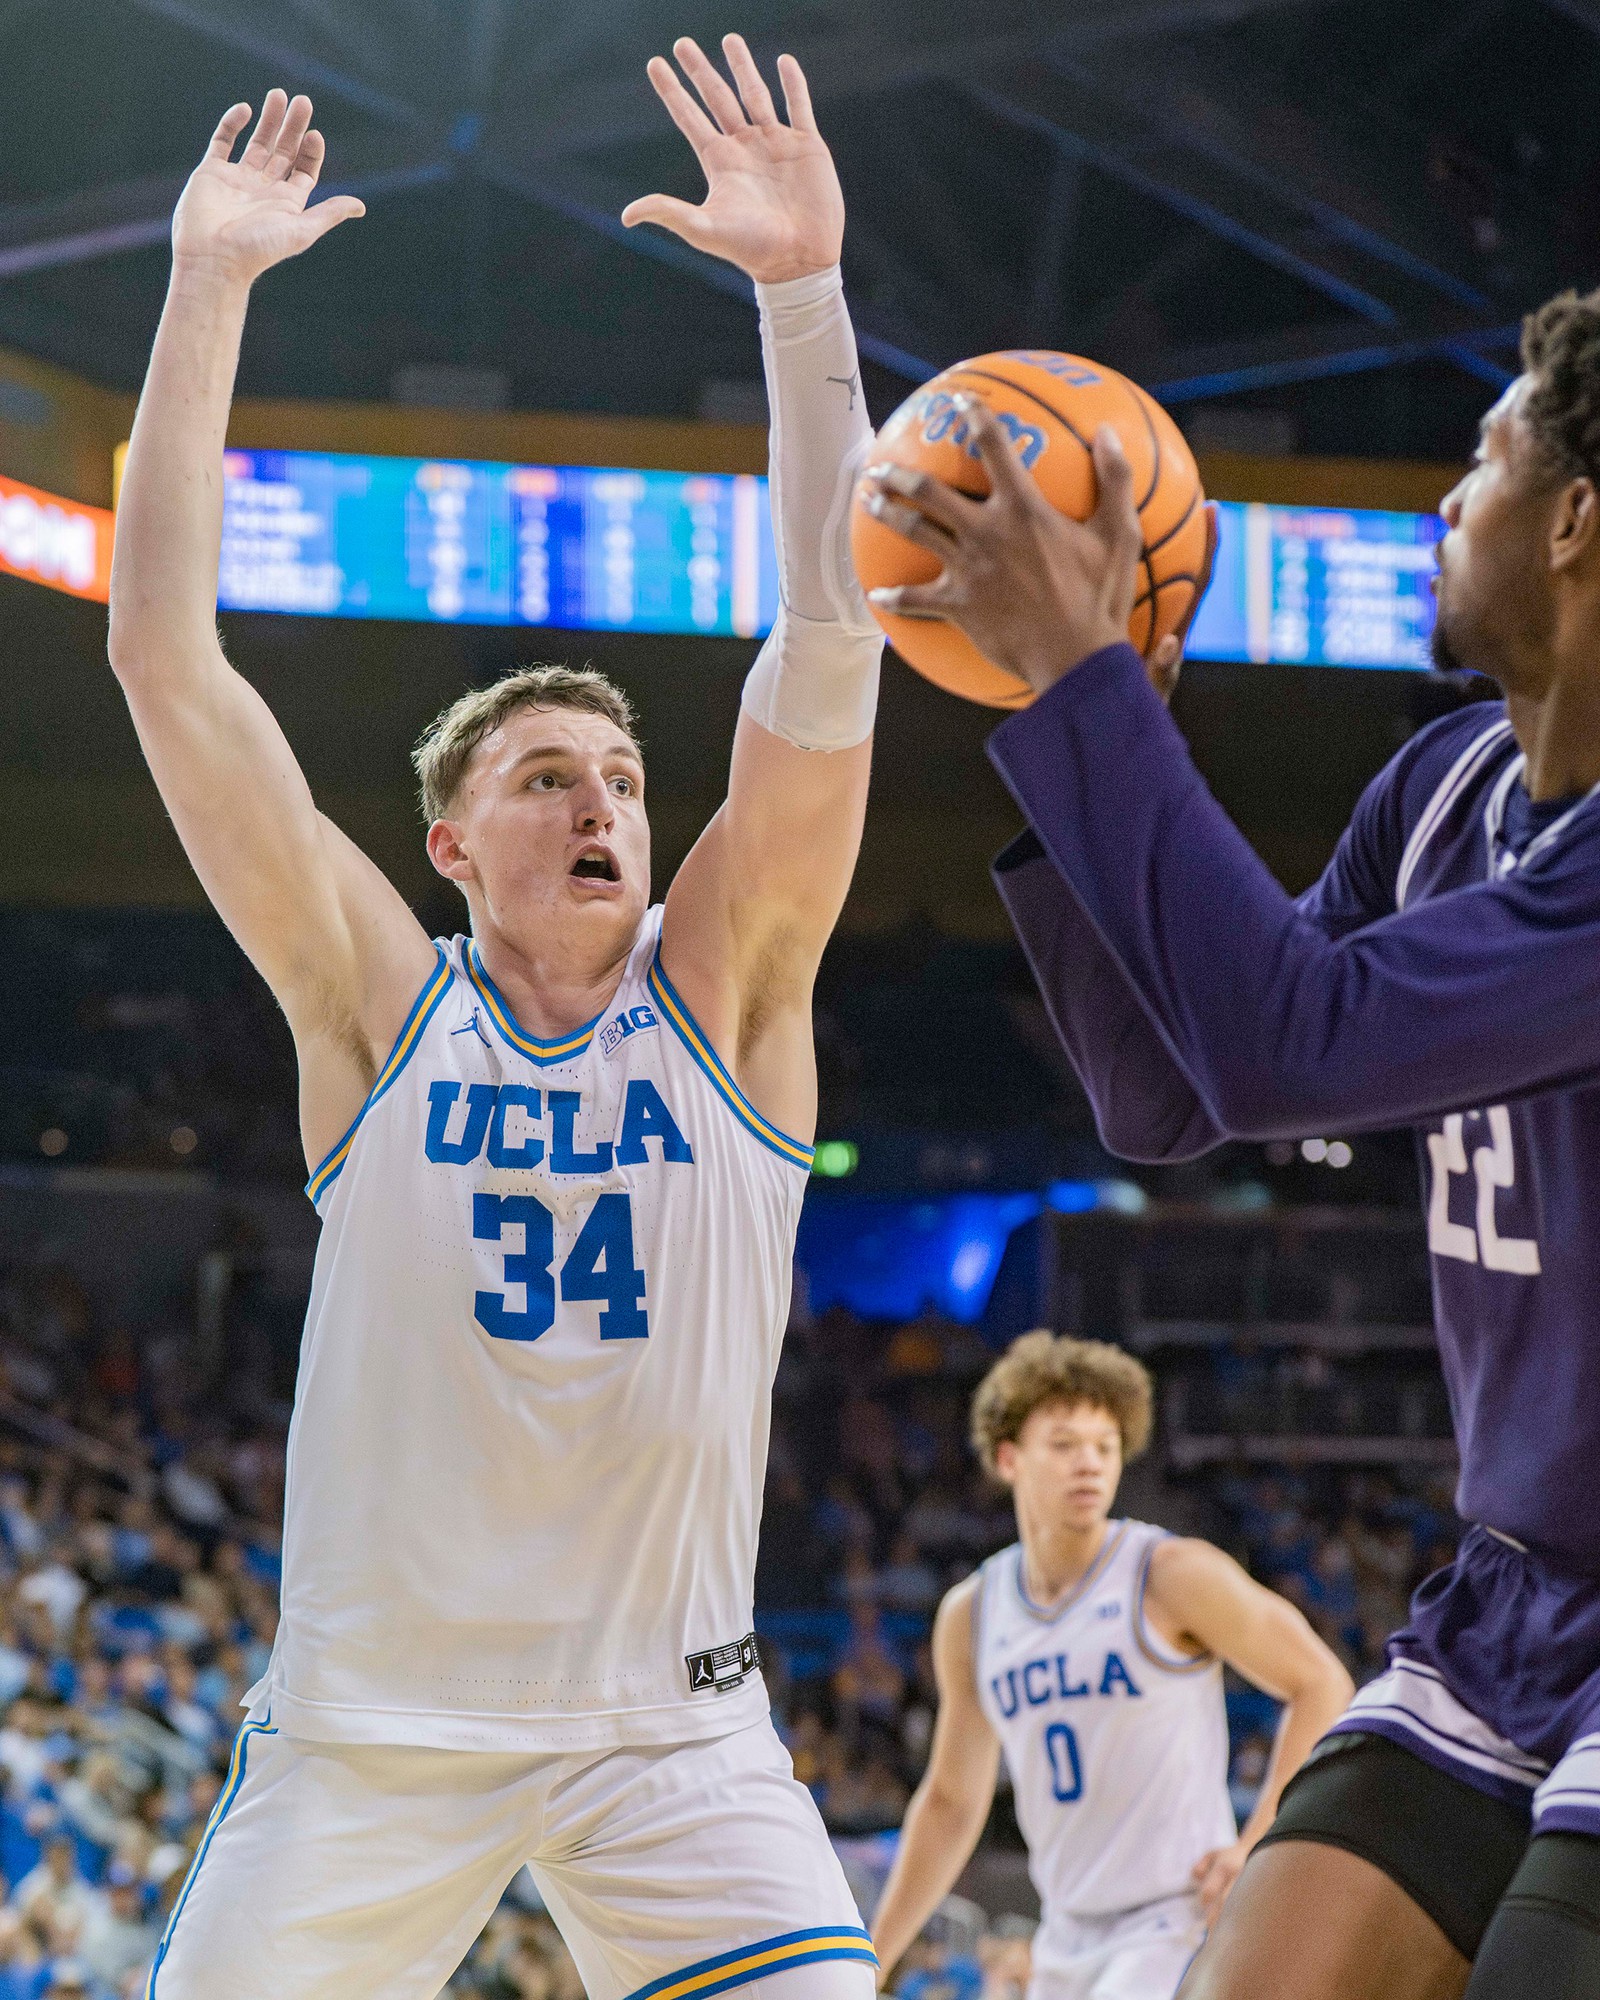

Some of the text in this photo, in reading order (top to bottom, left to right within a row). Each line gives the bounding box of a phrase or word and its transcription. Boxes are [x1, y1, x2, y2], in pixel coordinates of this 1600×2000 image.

[425, 1080, 695, 1174] UCLA
[1427, 1104, 1542, 1275] 22
[473, 1192, 649, 1342] 34
[991, 1652, 1142, 1719] UCLA
[1045, 1722, 1083, 1803] 0
